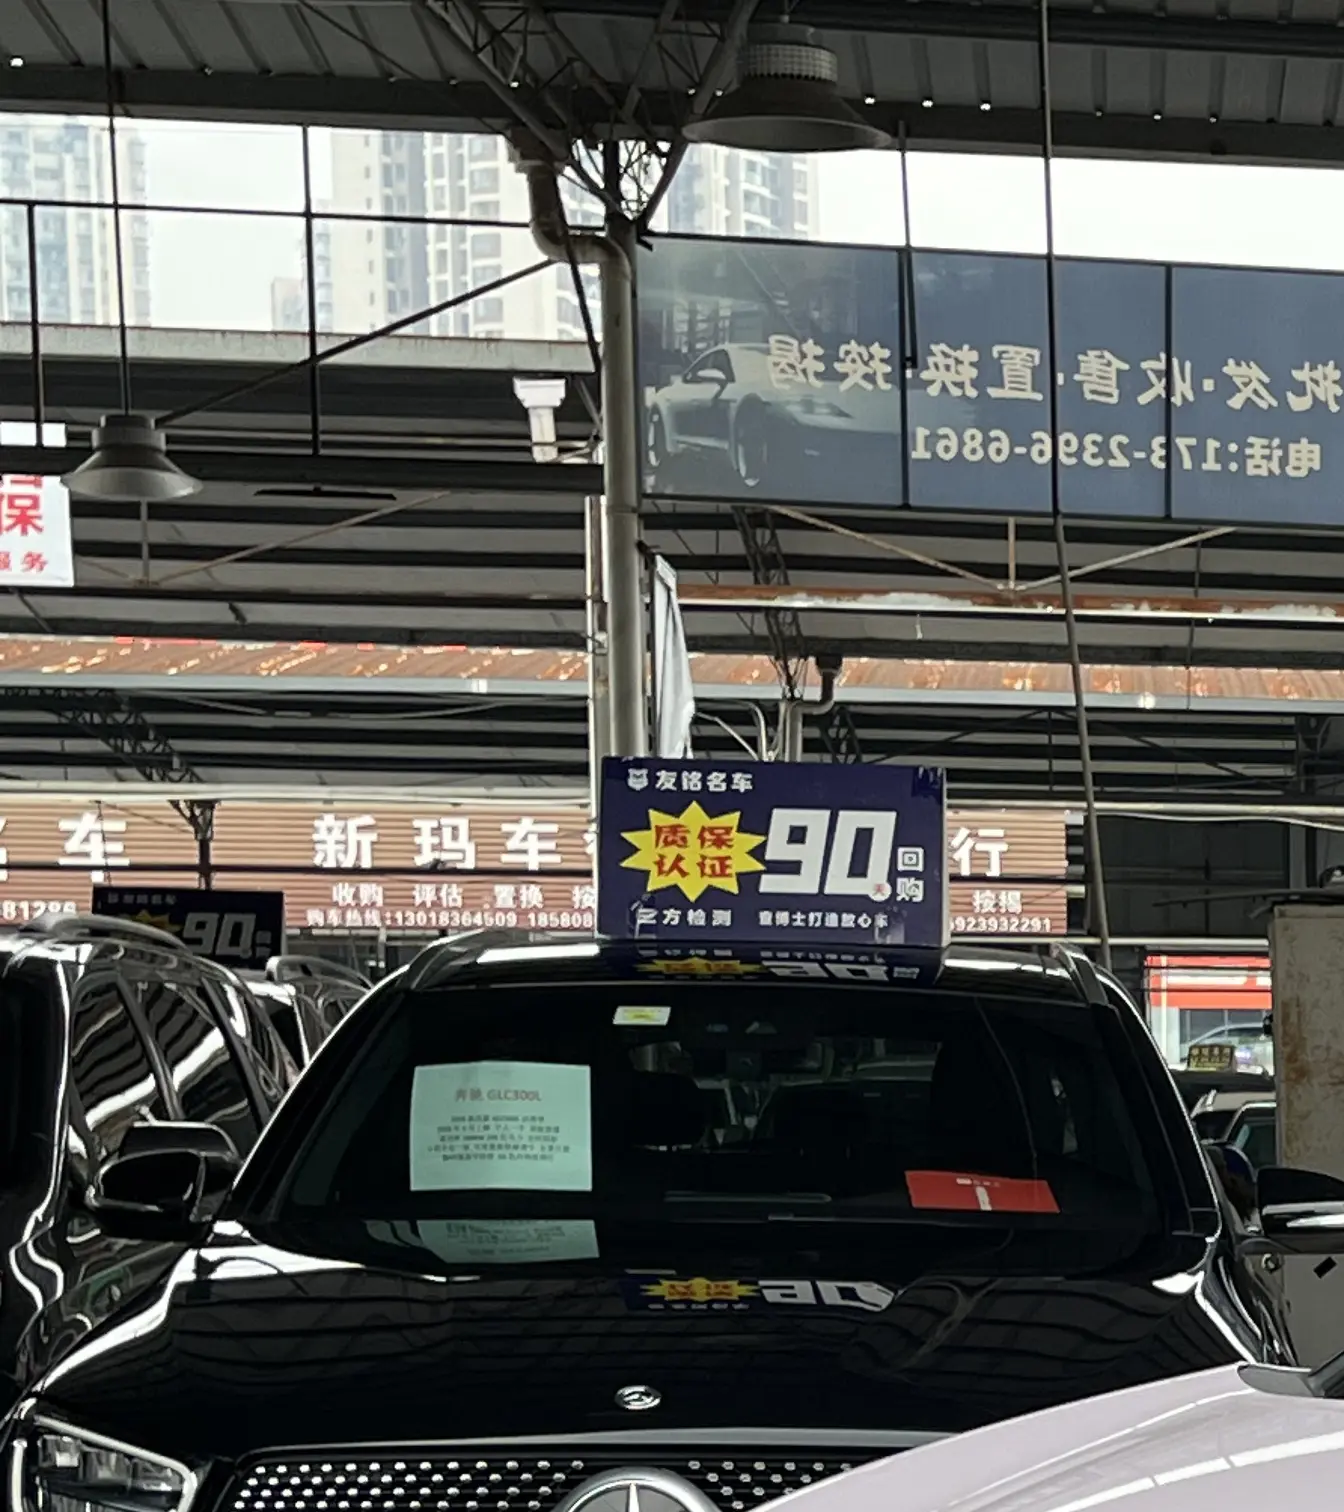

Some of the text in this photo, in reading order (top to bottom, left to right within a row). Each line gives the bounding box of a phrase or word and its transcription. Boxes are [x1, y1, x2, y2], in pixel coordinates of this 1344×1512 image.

[312, 813, 598, 870] 新玛车
[653, 823, 735, 851] 质保
[758, 808, 897, 896] 90
[950, 827, 1009, 877] 行
[654, 854, 735, 880] 认证
[896, 846, 925, 903] 回购
[332, 882, 384, 907] 收购
[412, 883, 464, 909] 评估
[493, 884, 545, 909] 置换
[972, 889, 1022, 915] 按揭
[182, 912, 256, 956] 90
